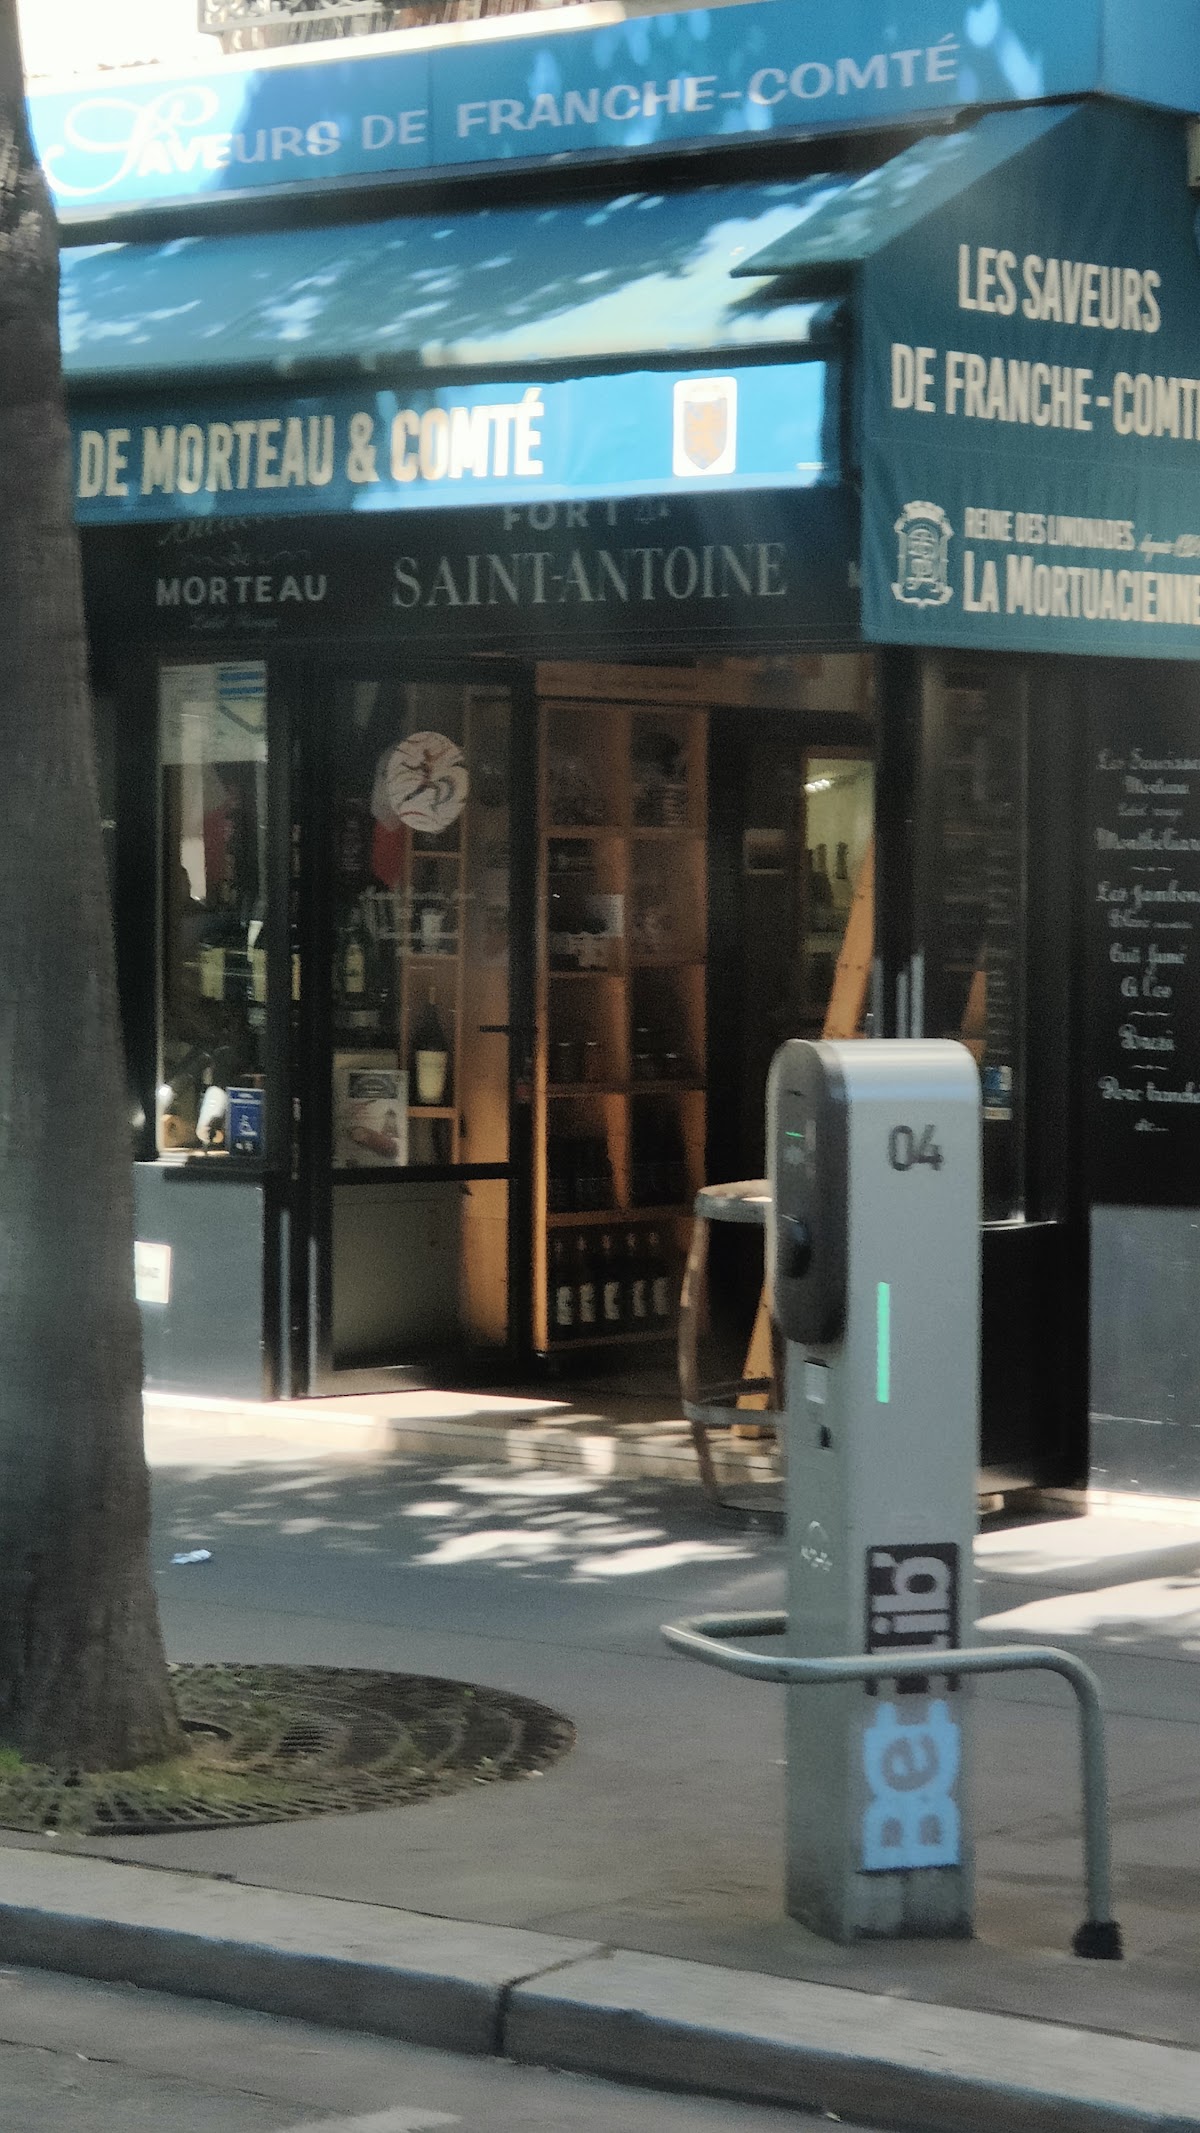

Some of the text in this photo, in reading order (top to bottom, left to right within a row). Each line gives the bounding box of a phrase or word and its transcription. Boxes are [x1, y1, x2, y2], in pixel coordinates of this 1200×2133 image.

[362, 109, 428, 150] DE
[457, 33, 961, 138] FRANCHE-COMTÉ
[958, 243, 1162, 333] LES SAVEURS
[891, 342, 937, 413] DE
[77, 387, 545, 498] DE MORTEAU & COMTÉ
[156, 573, 328, 606] MORTEAU
[392, 541, 788, 608] SAINT-ANTOINE
[887, 1124, 945, 1171] 04
